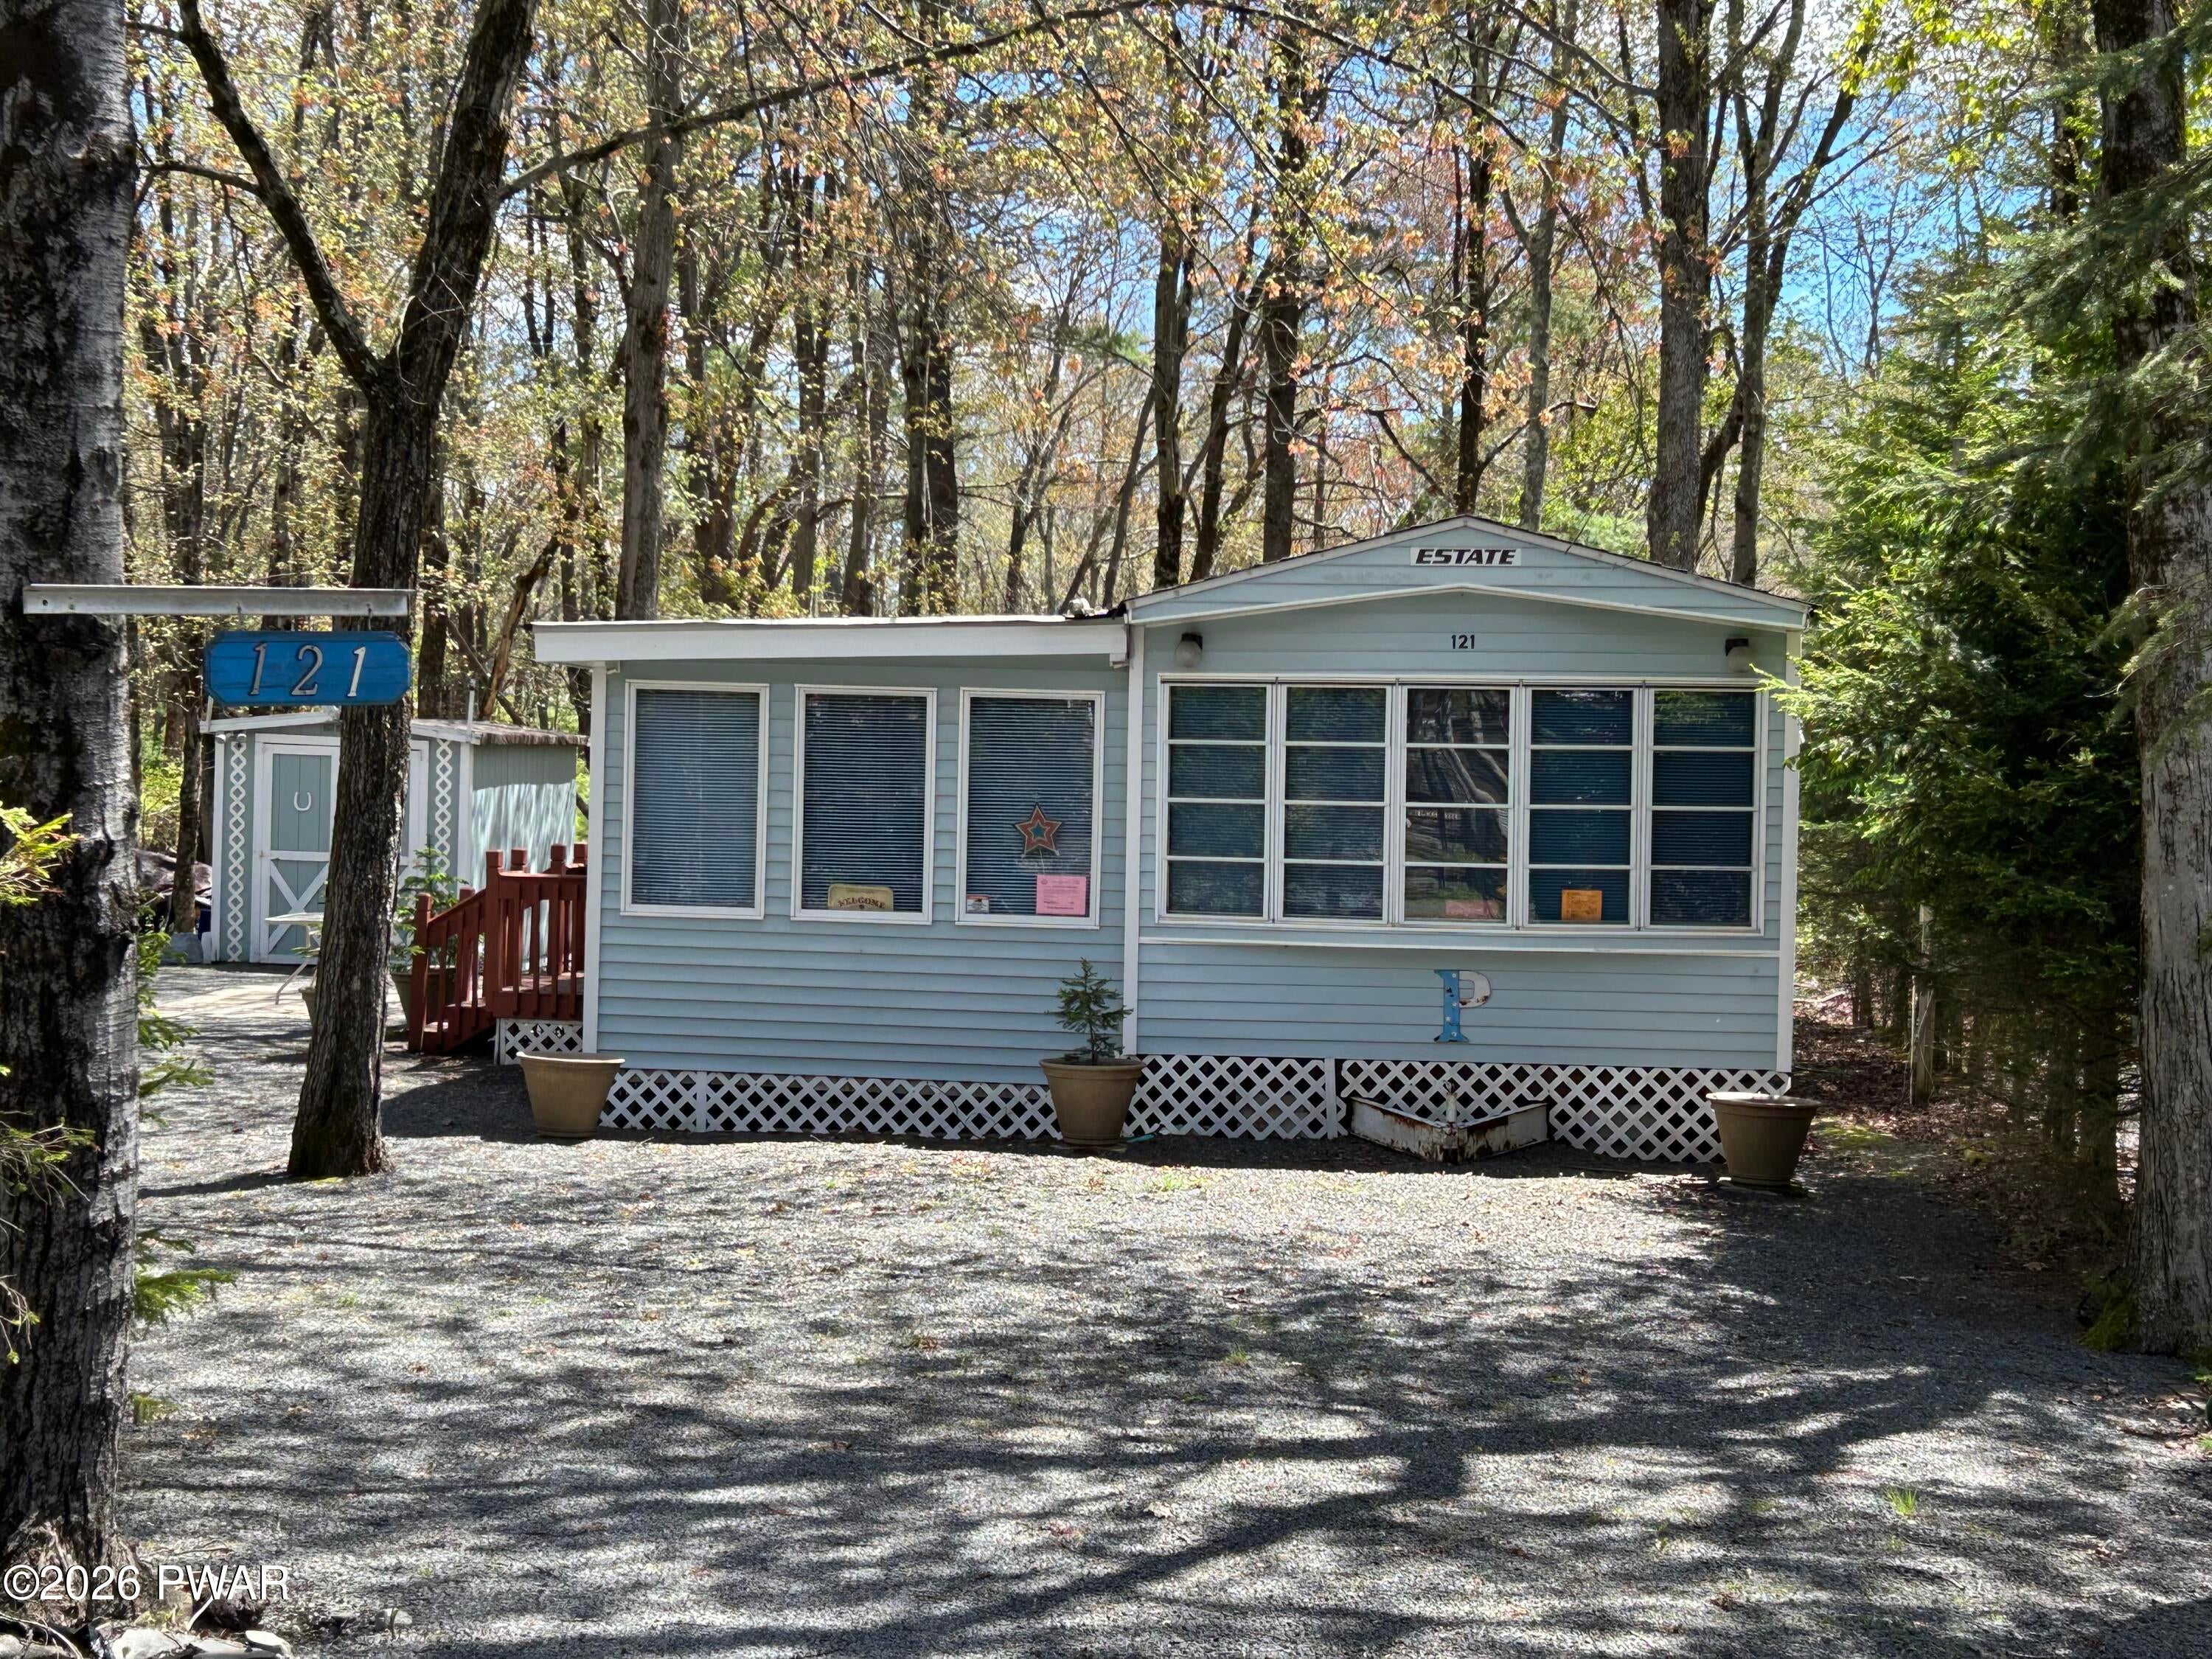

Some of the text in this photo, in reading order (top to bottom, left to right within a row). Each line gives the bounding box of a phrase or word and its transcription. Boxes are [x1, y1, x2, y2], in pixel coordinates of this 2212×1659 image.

[1416, 549, 1517, 565] ESTATE
[1451, 634, 1475, 650] 121
[248, 642, 367, 698] 121
[1433, 969, 1492, 1043] P
